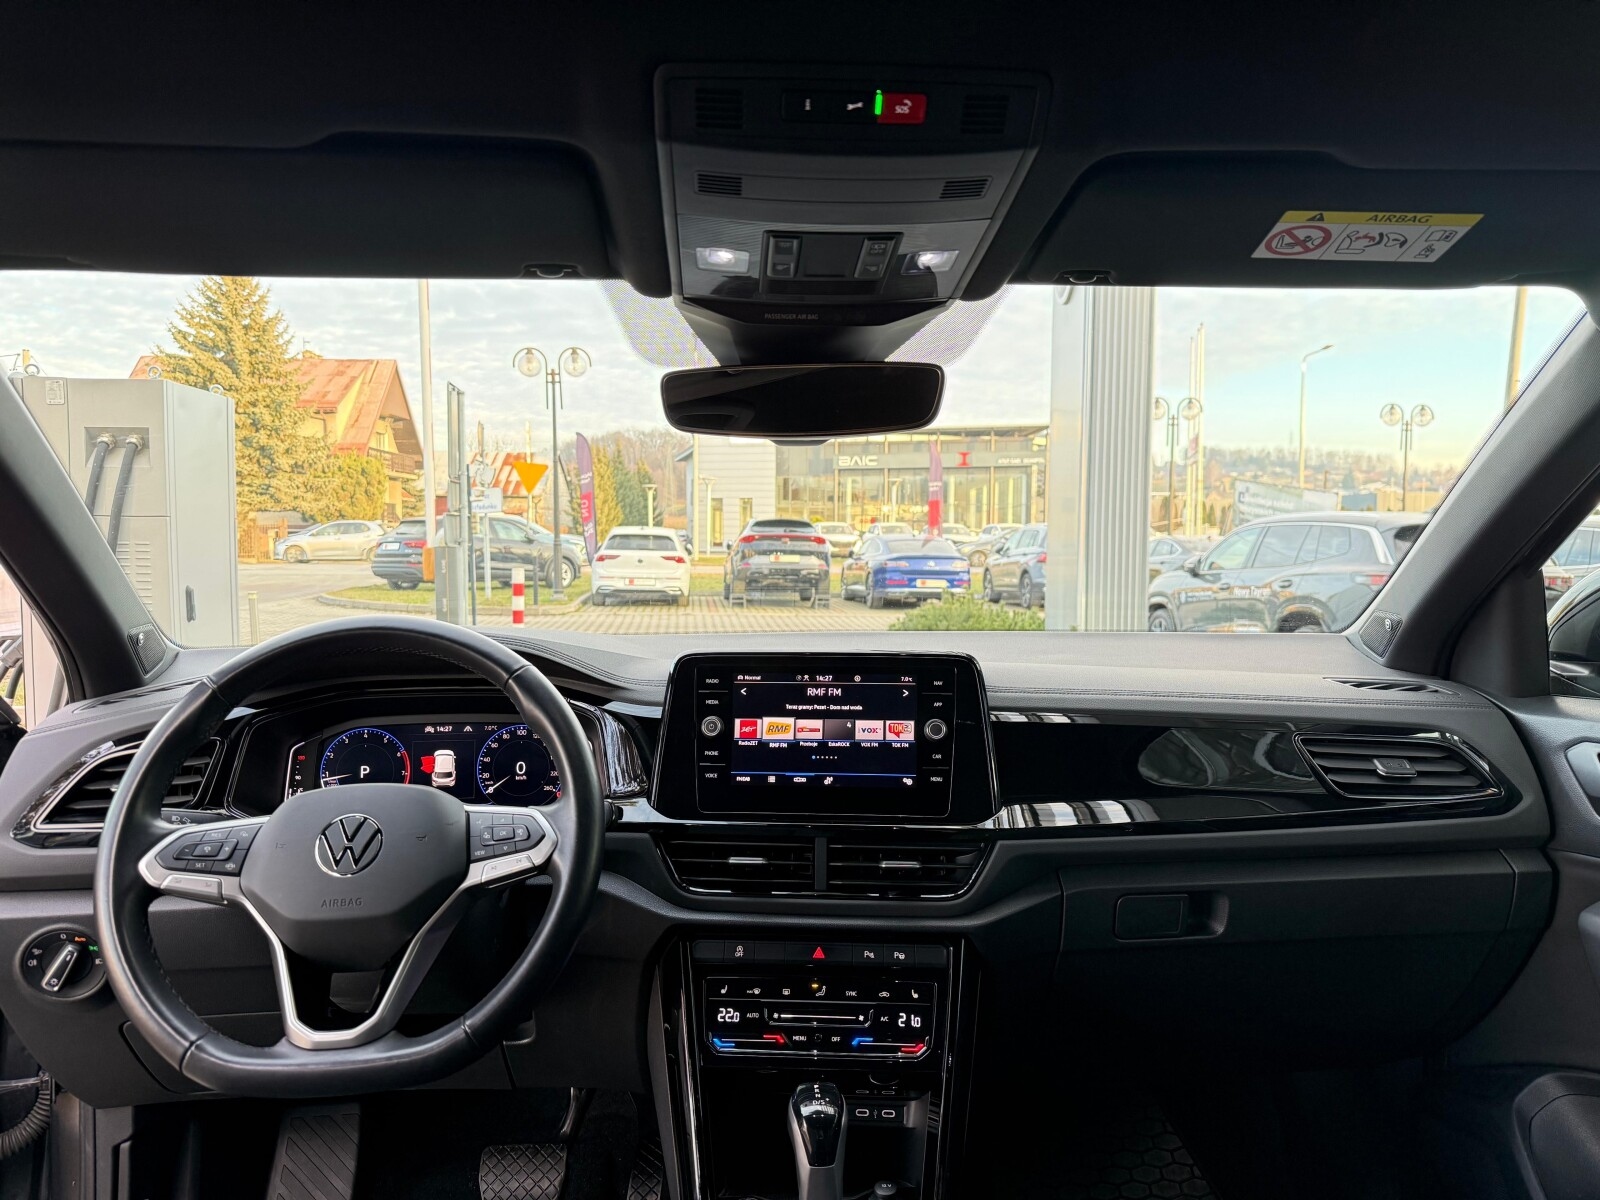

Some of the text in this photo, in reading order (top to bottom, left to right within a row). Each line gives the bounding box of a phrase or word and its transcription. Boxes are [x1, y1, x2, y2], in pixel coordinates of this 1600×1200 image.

[895, 105, 910, 114] SOS
[1366, 214, 1433, 224] AIRBAG
[838, 455, 878, 466] BAIC
[807, 687, 842, 697] RMF FM
[768, 724, 790, 734] RMF
[360, 766, 370, 778] P
[516, 761, 526, 775] 0
[321, 897, 363, 909] AIRBAG
